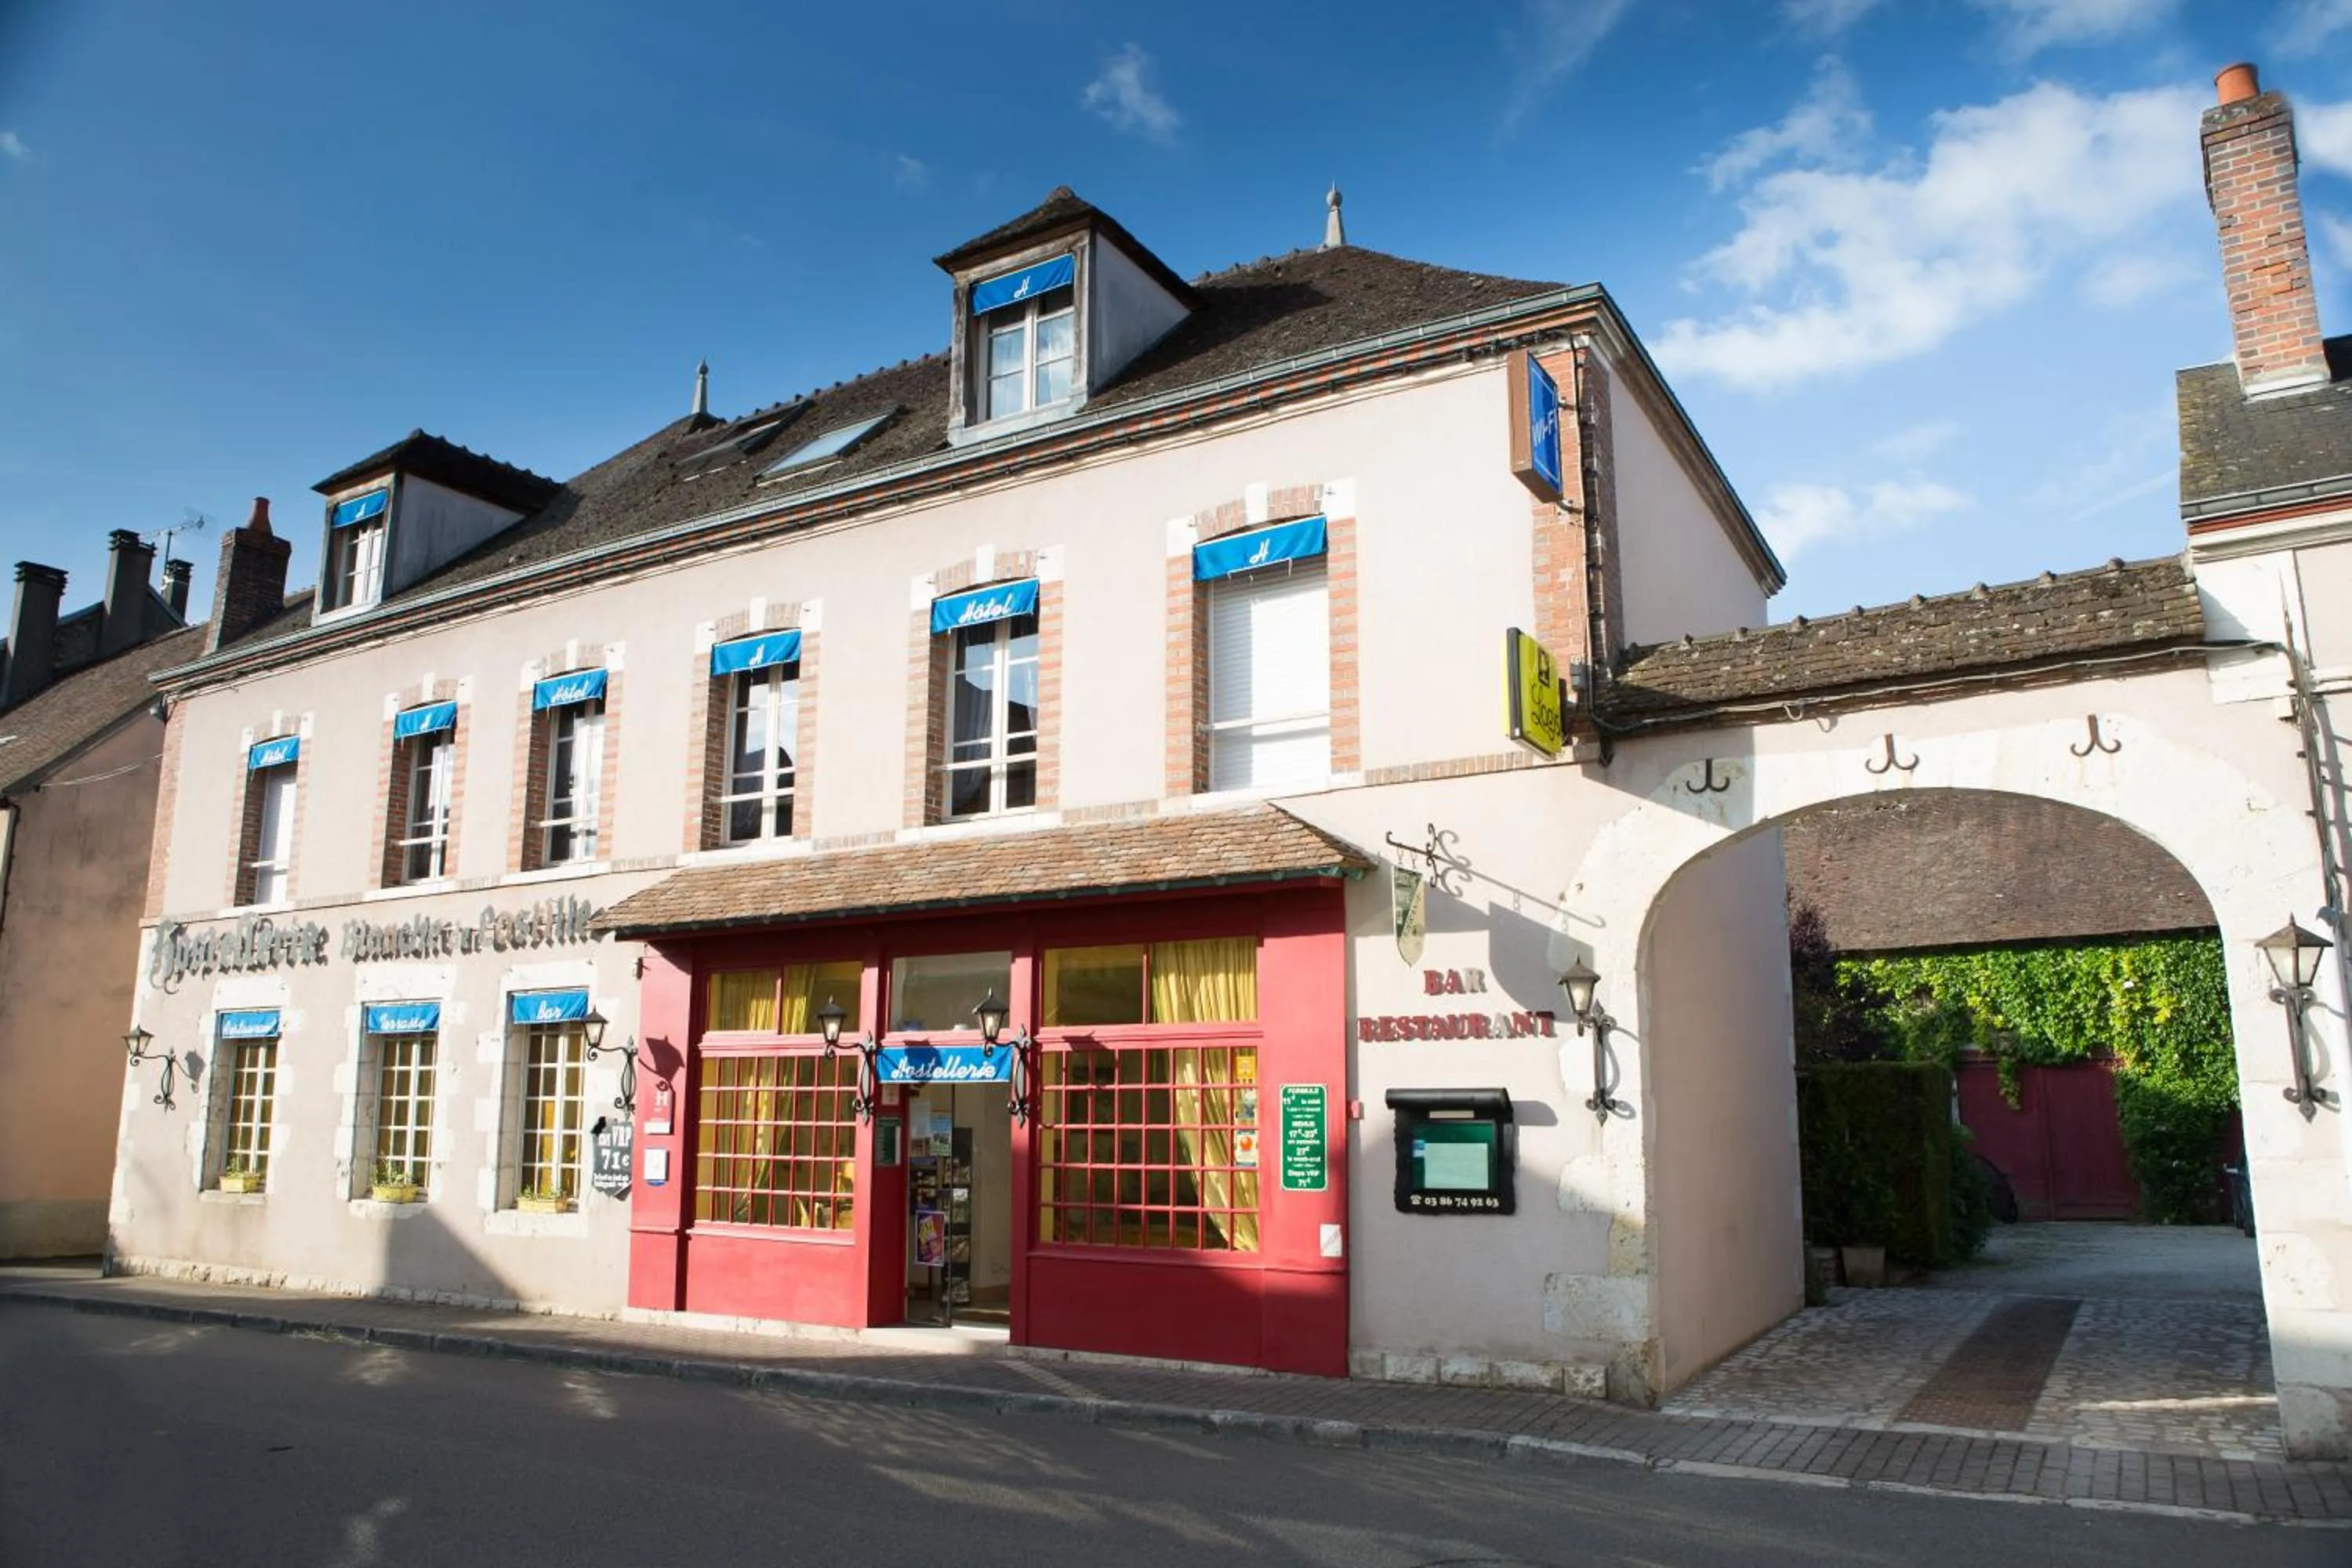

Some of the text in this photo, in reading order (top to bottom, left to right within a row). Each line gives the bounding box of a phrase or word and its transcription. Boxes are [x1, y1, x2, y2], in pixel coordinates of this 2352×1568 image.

[1423, 968, 1488, 996] BAR
[1357, 1011, 1558, 1043] RESTAURANT
[891, 1054, 996, 1079] Hostellerie
[612, 1125, 631, 1146] VRP
[1454, 1196, 1468, 1207] 74
